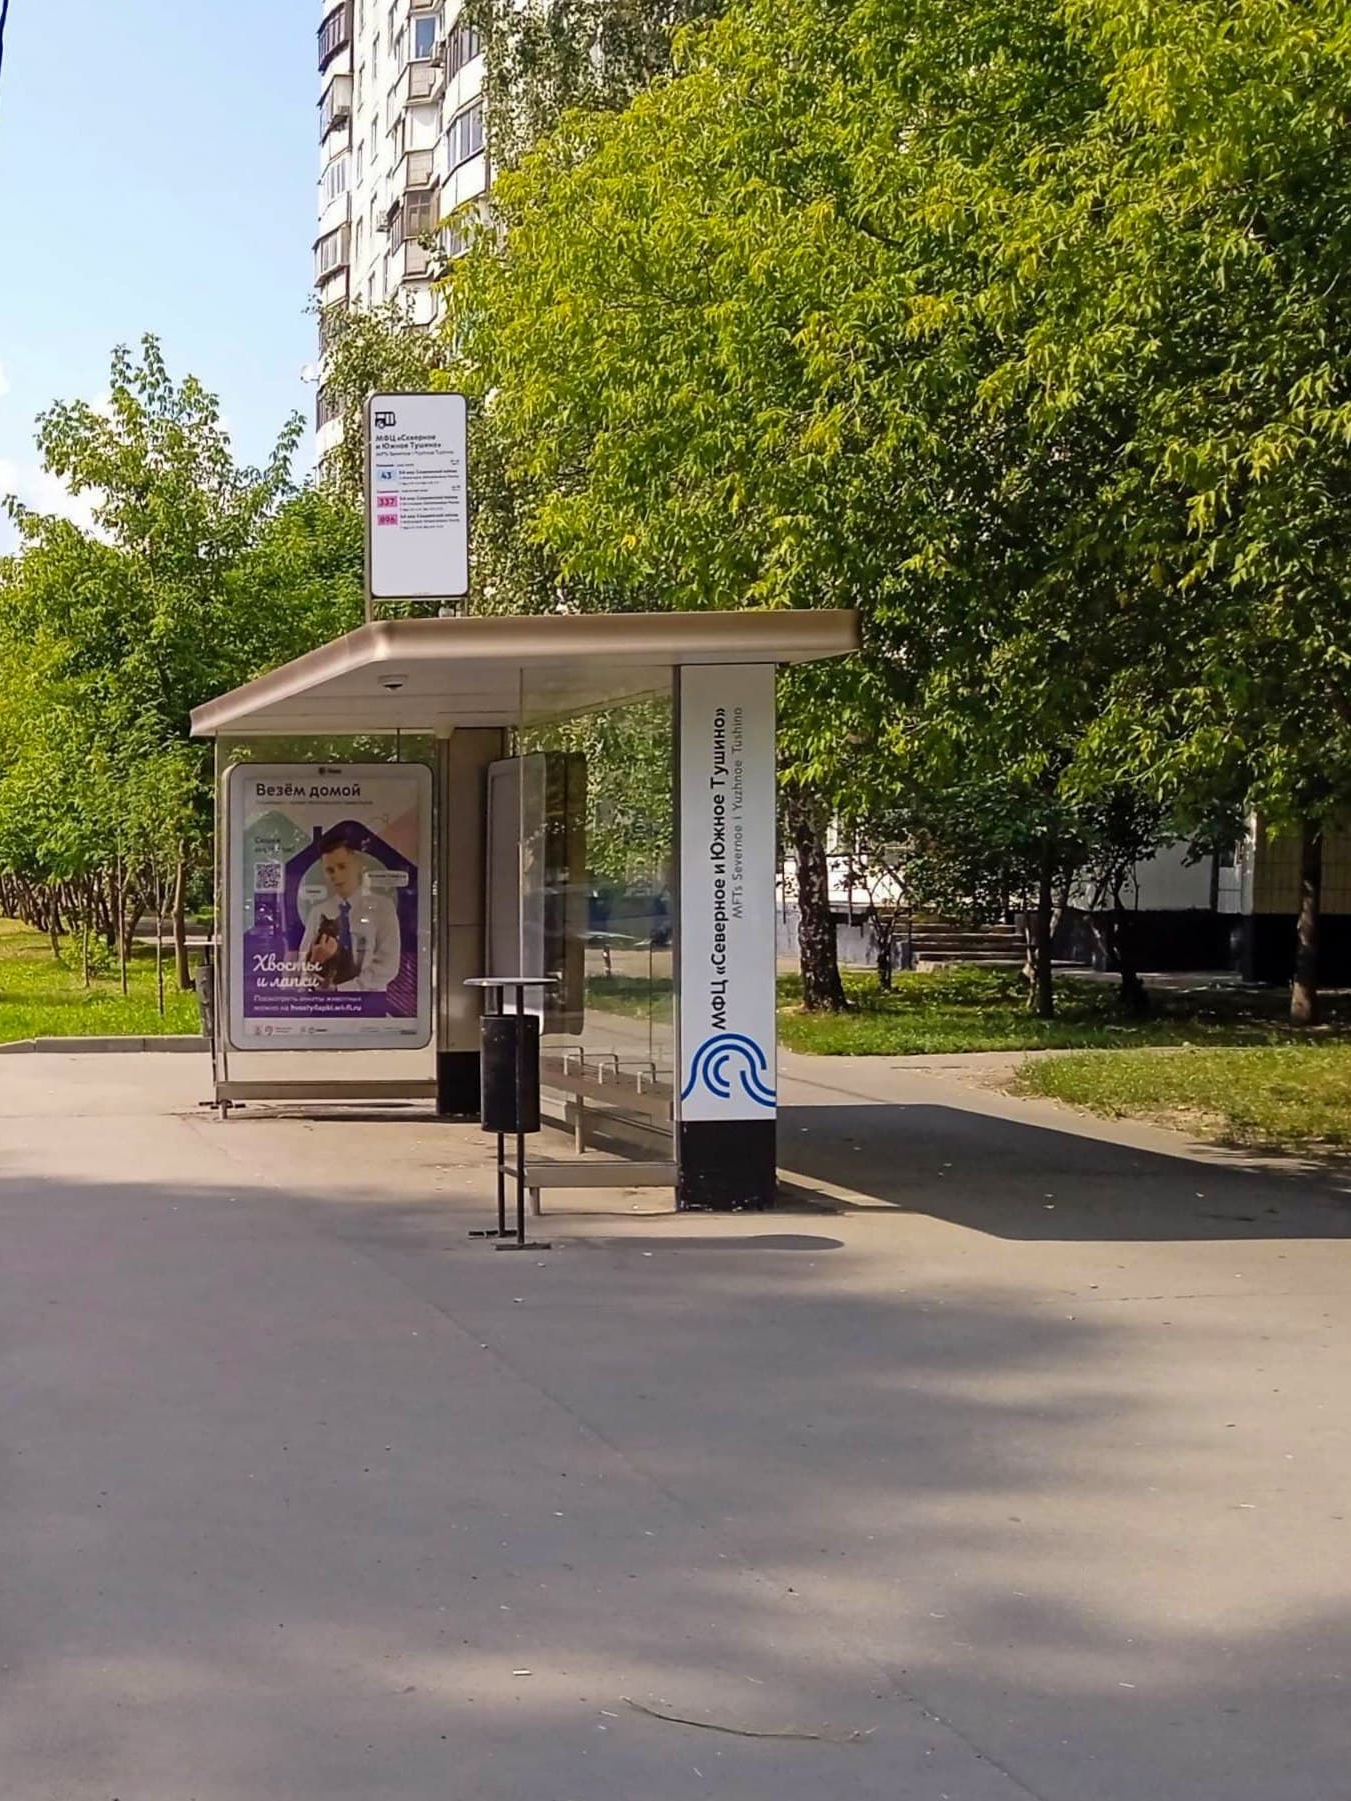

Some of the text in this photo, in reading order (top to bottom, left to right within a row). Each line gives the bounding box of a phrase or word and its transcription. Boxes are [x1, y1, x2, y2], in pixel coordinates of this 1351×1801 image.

[381, 471, 392, 480] 43
[732, 707, 743, 754] Tushino
[256, 783, 361, 798] Везём домой
[732, 760, 743, 811] Yuzhnoe
[710, 707, 729, 1030] МФЦ «Северное и Южное Тушино»
[732, 825, 743, 881] Severnoe
[732, 886, 743, 919] MFTs
[253, 953, 323, 972] Хвосты
[256, 976, 320, 988] и лапки
